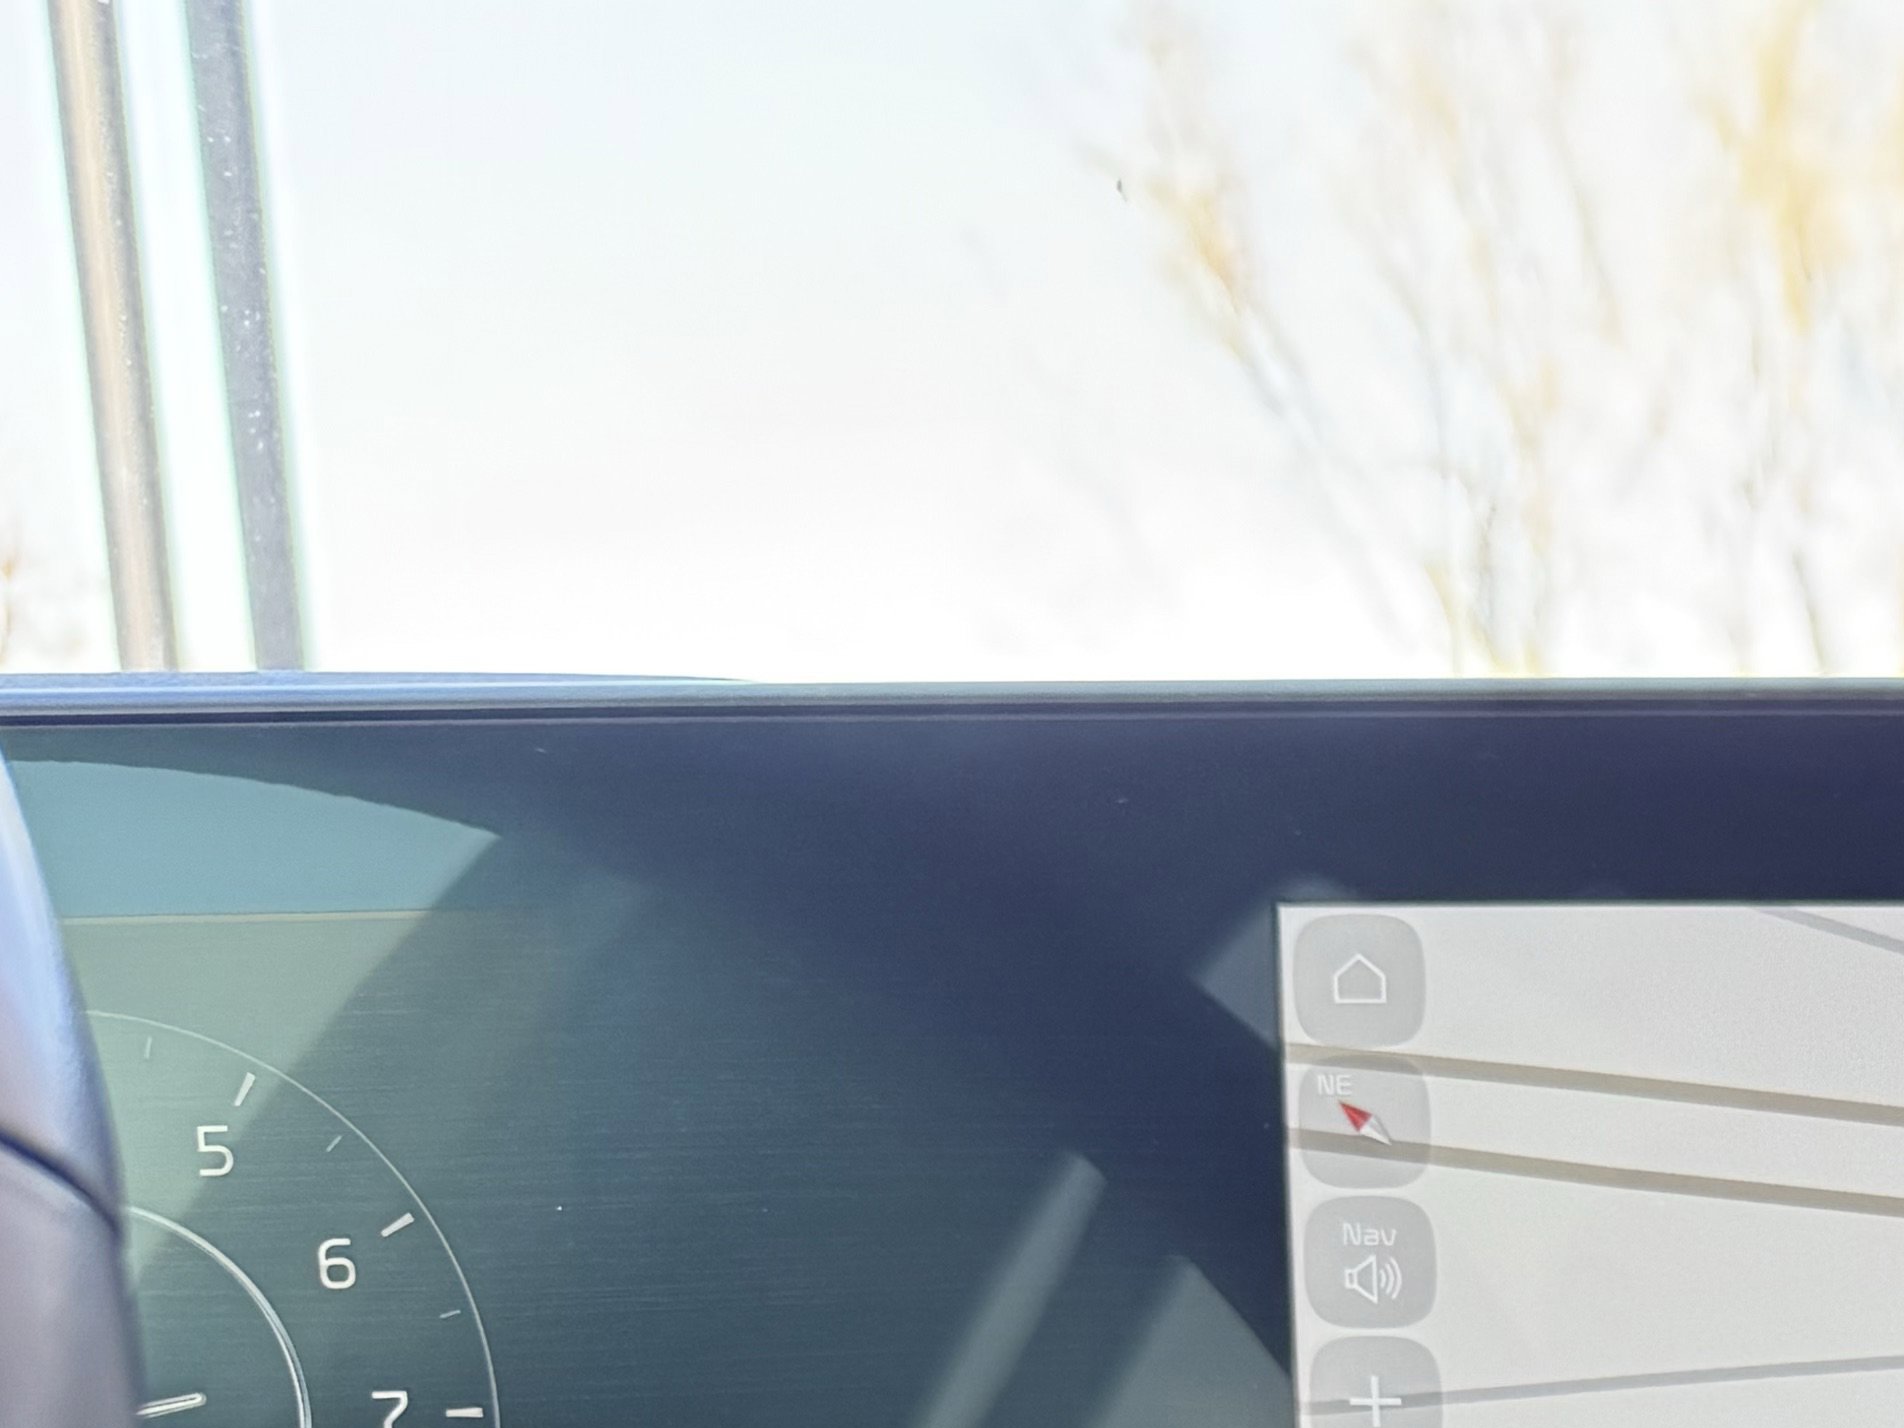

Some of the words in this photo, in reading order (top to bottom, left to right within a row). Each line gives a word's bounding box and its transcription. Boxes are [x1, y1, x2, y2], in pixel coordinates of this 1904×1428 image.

[1317, 1074, 1353, 1096] NE
[197, 1125, 234, 1176] 5
[1342, 1223, 1397, 1247] Nav
[317, 1238, 357, 1289] 6
